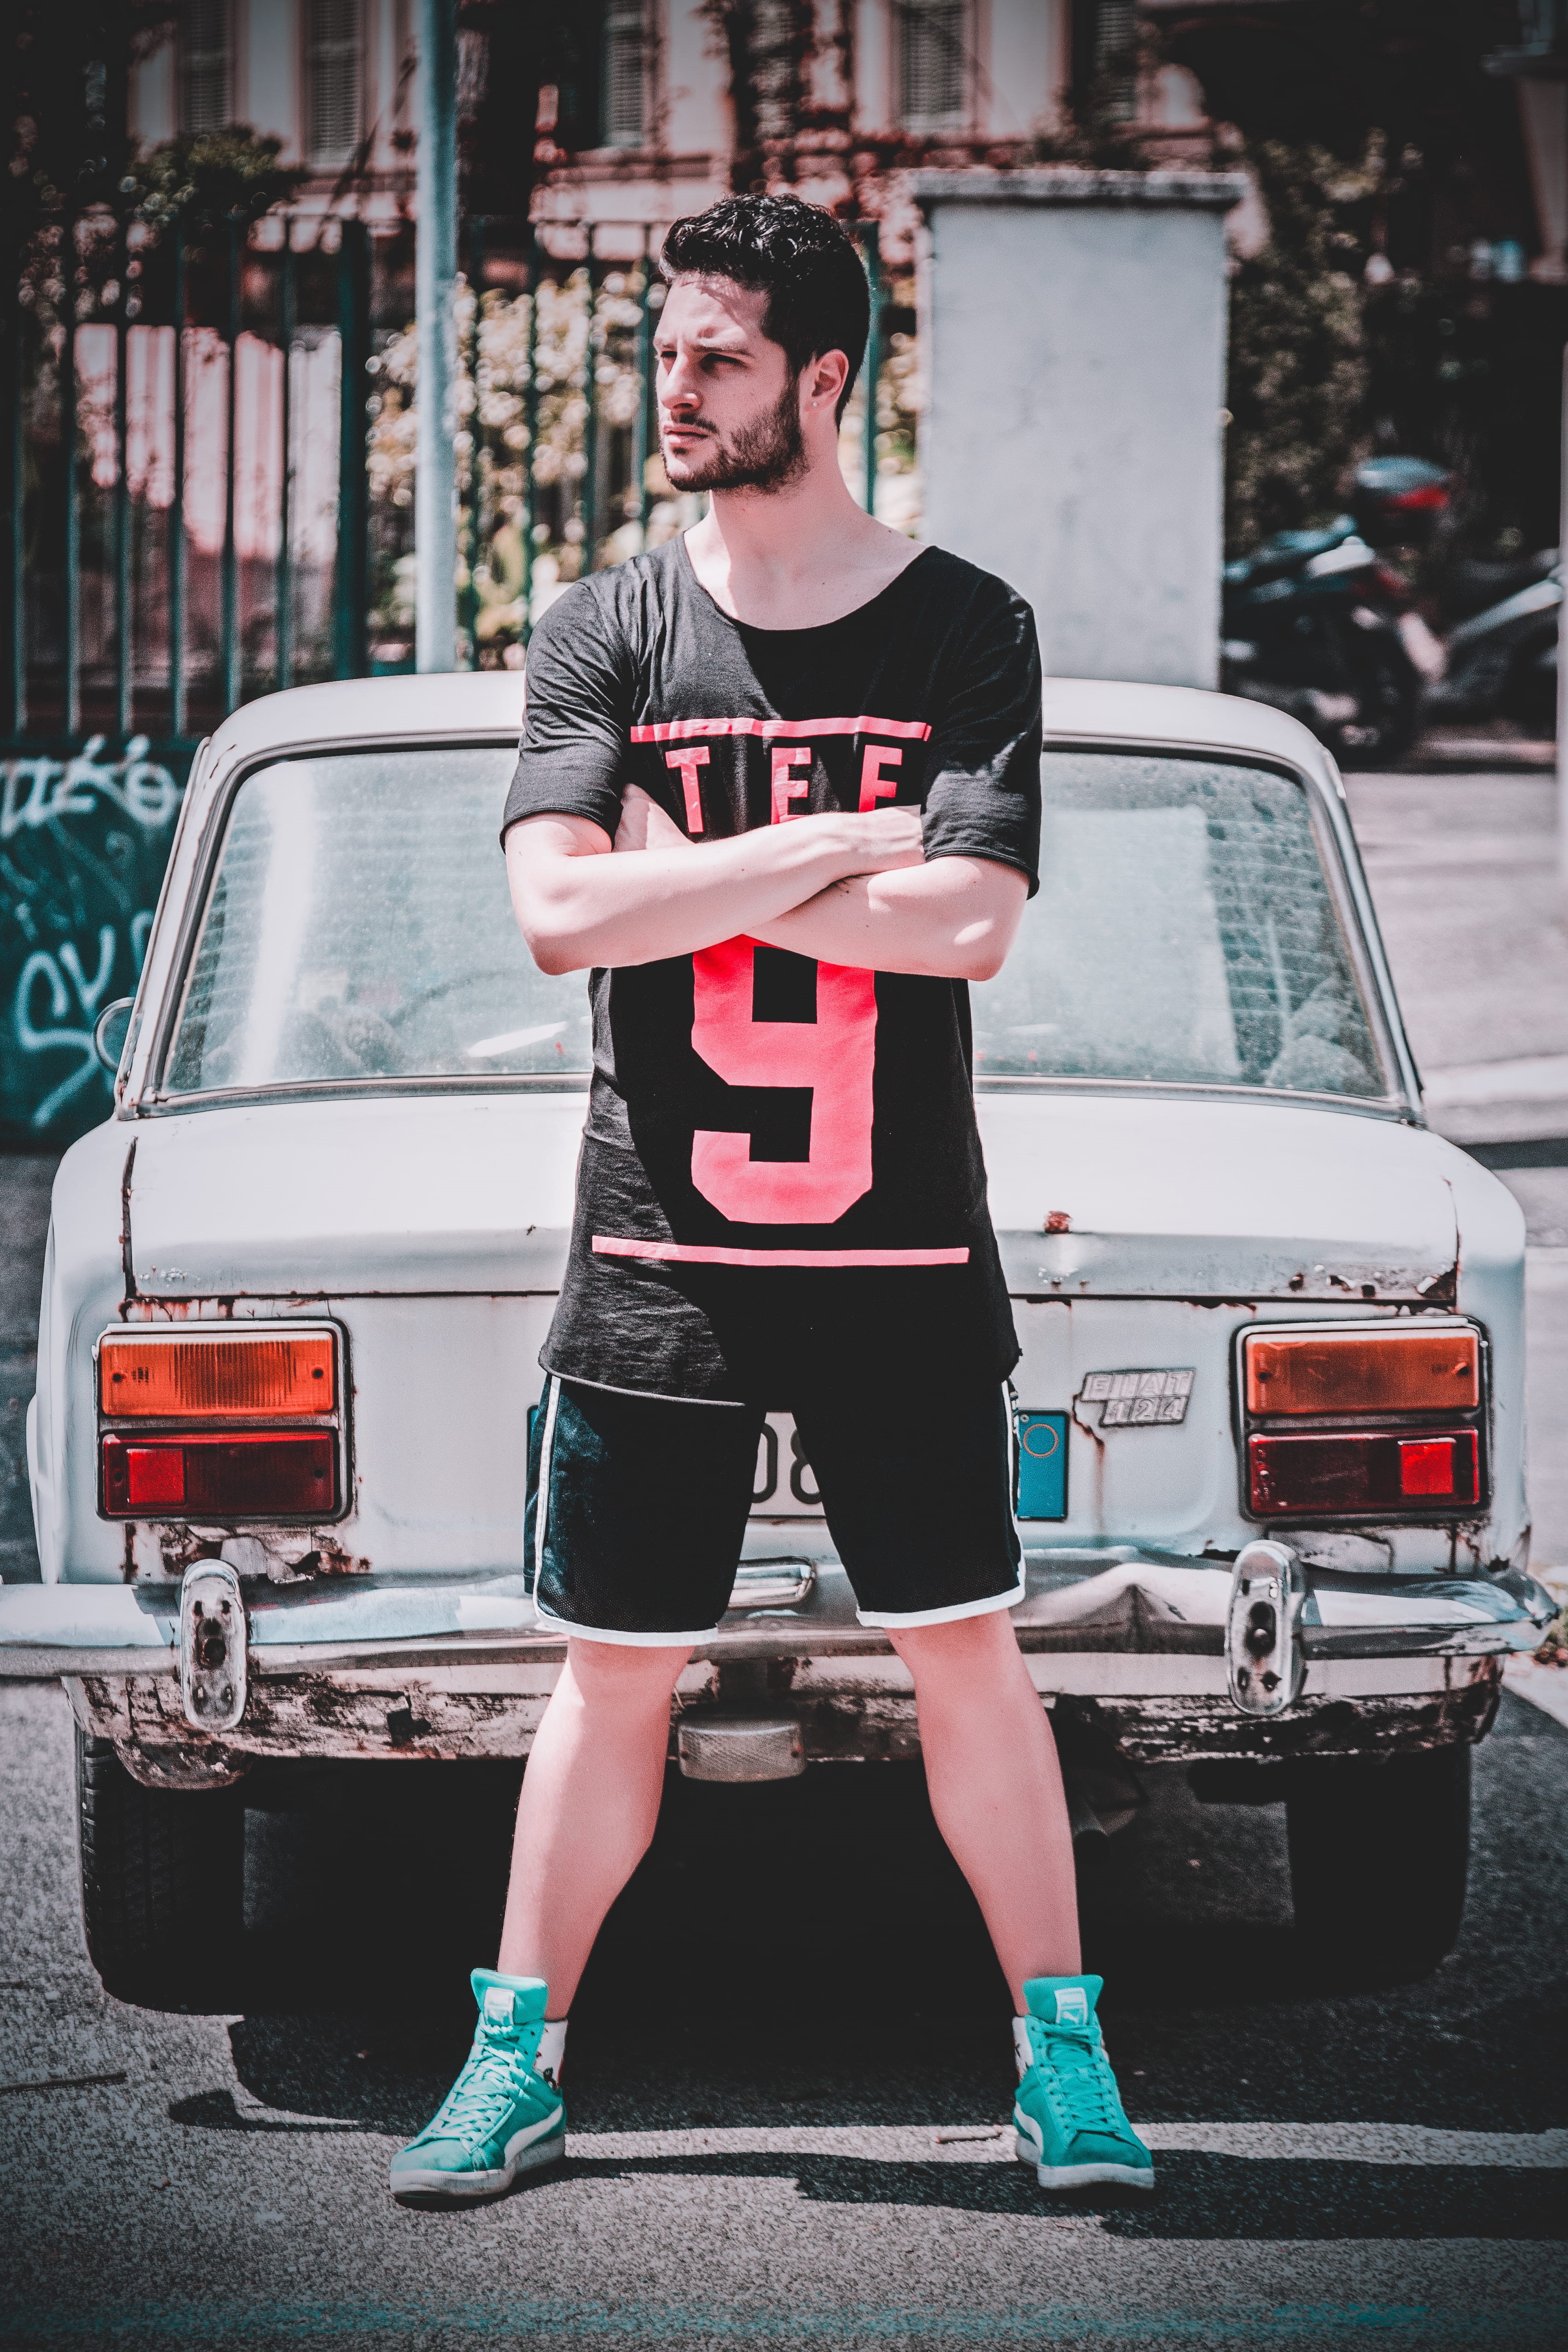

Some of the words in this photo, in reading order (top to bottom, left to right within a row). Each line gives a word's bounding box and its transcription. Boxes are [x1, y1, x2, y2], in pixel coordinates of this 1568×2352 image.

[691, 934, 877, 1223] 9
[1084, 1371, 1194, 1399] FIAT
[1104, 1398, 1186, 1423] 124
